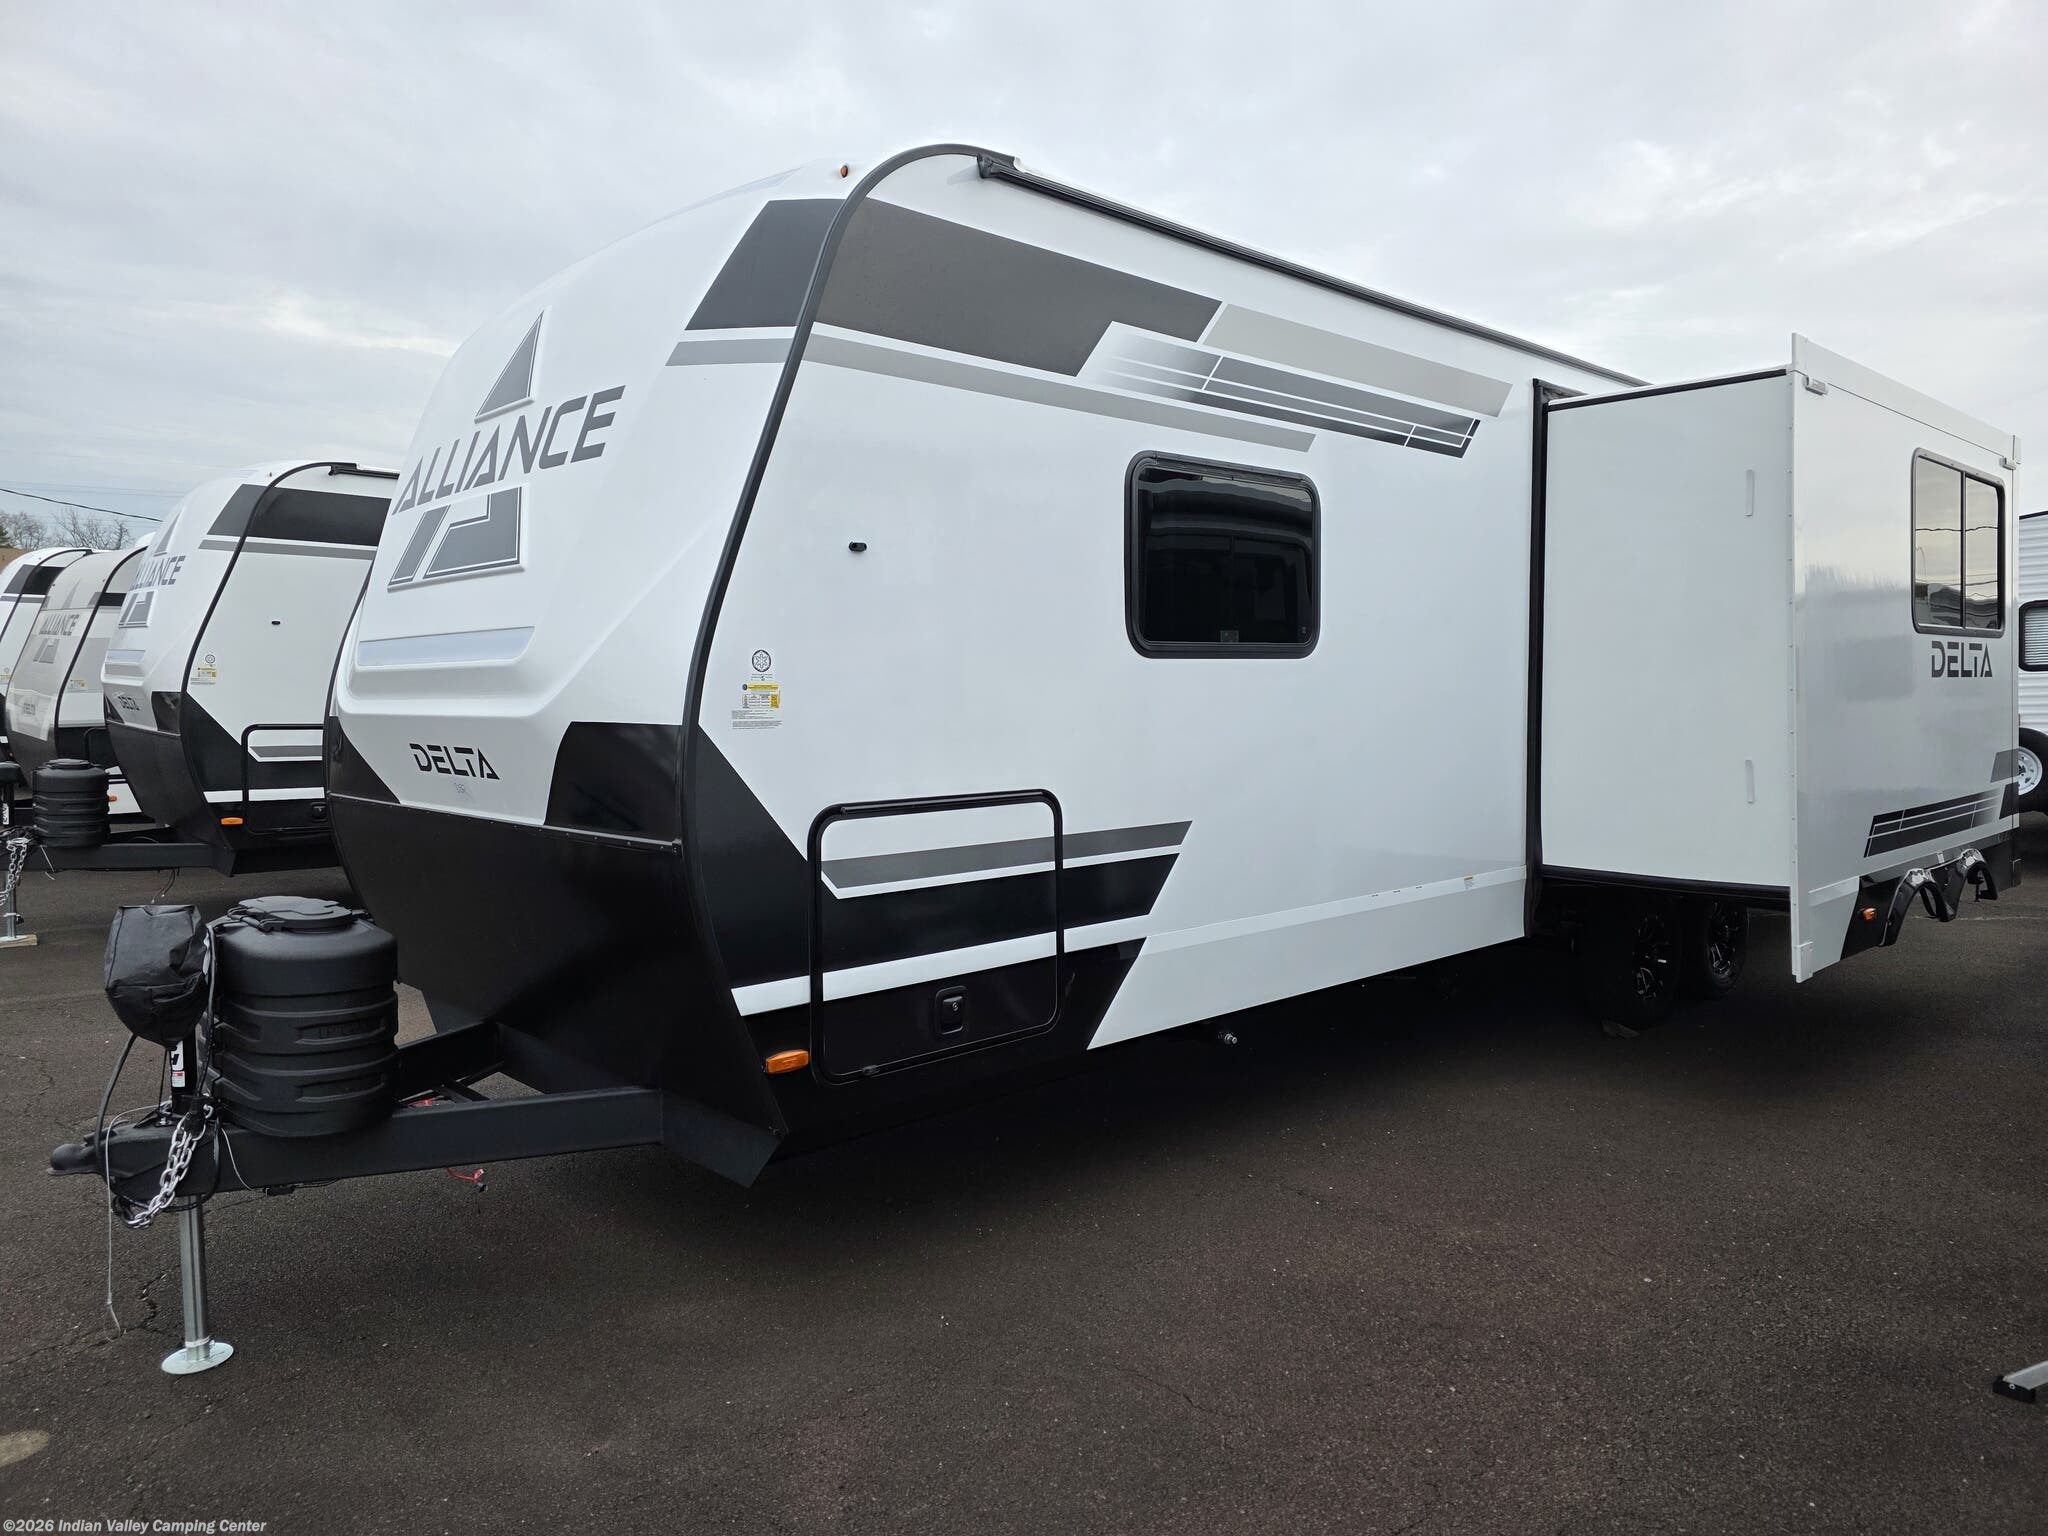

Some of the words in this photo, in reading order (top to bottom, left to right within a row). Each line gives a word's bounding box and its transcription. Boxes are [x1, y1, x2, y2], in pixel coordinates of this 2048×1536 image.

[392, 385, 626, 515] ALLIANCE
[129, 555, 186, 591] ALLIANCE
[1931, 640, 1993, 678] DELTA
[409, 743, 500, 780] DELTA
